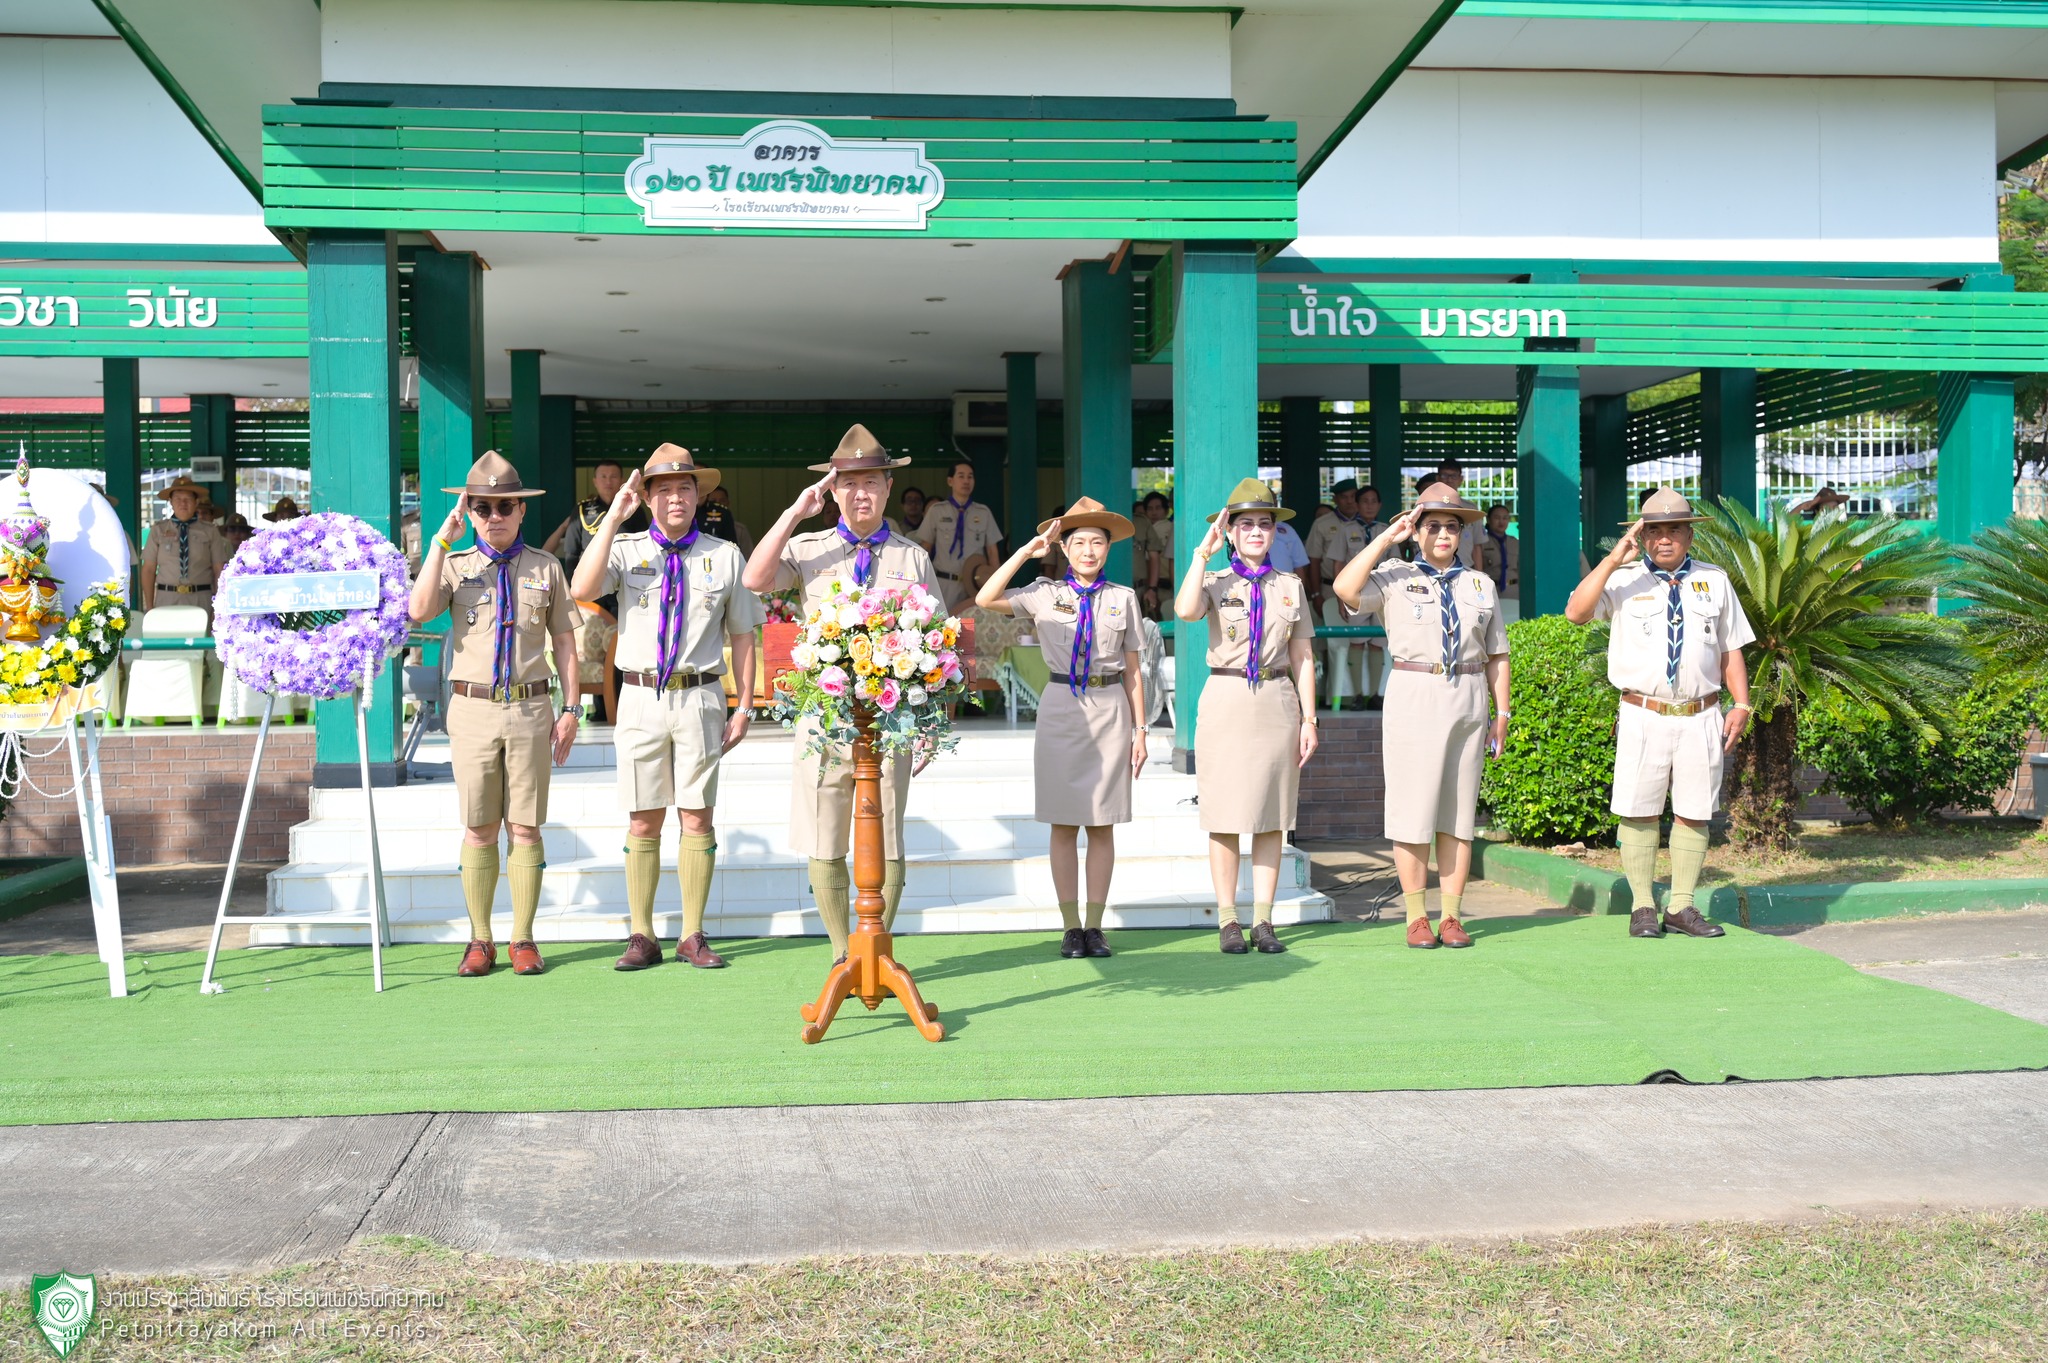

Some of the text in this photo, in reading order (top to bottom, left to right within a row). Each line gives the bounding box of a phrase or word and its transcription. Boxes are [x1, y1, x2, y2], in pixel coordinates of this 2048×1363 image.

[754, 143, 821, 162] อาคาร
[645, 165, 928, 196] ๑๒๐ ปี เพชรพิทยาคม
[723, 197, 849, 214] โรงเรียนเพชรพิทยาคม
[0, 286, 218, 328] วิชา วินัย
[1289, 284, 1567, 337] น้ำใจ มารยาท
[233, 579, 372, 608] โรงเรีบ้านโพธิ์ทอง
